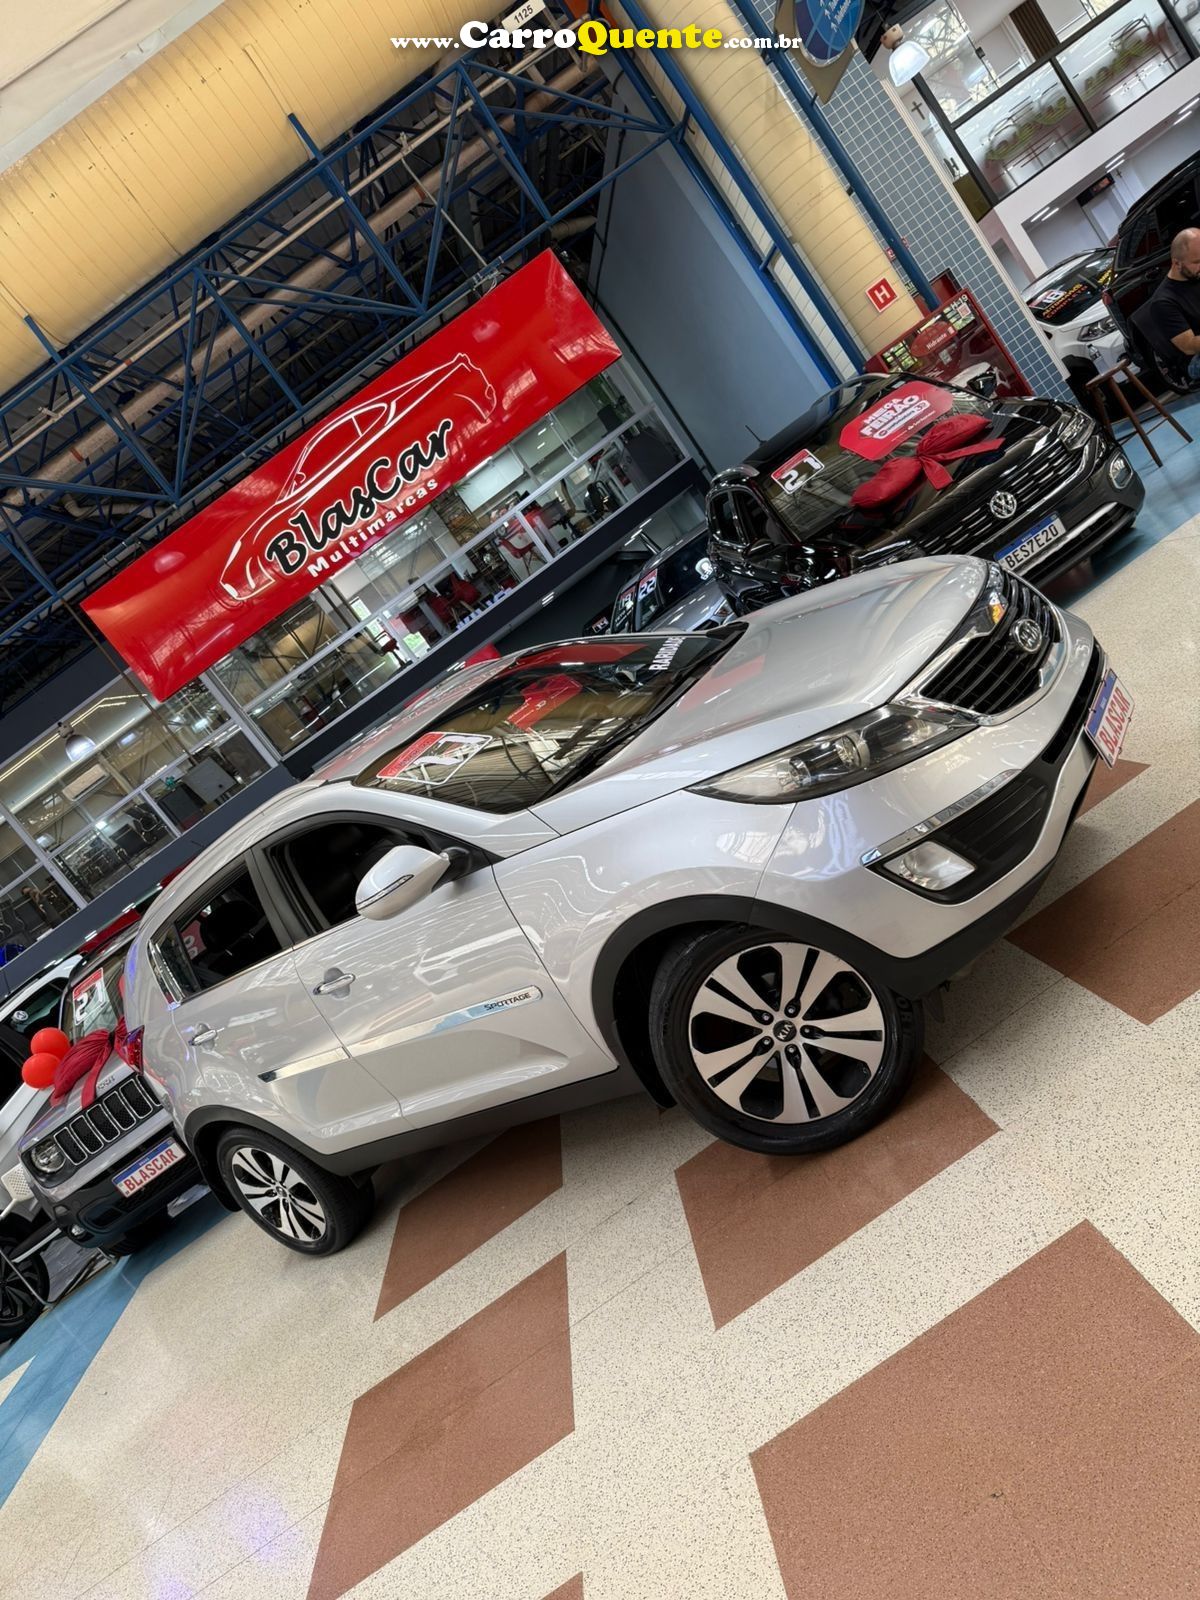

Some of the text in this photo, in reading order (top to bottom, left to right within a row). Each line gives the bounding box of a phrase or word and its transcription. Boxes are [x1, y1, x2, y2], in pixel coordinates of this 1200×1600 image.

[513, 4, 534, 25] 1125
[873, 284, 892, 304] H
[780, 455, 822, 491] 21
[265, 418, 453, 575] BlasCar
[307, 479, 438, 578] Multimarcas
[1004, 523, 1059, 569] BES7E20
[638, 576, 657, 602] 22
[1098, 686, 1131, 756] BLASCAR
[74, 982, 104, 1024] 21
[483, 991, 531, 1011] SPORTAGE
[123, 1148, 178, 1191] BLASCAR
